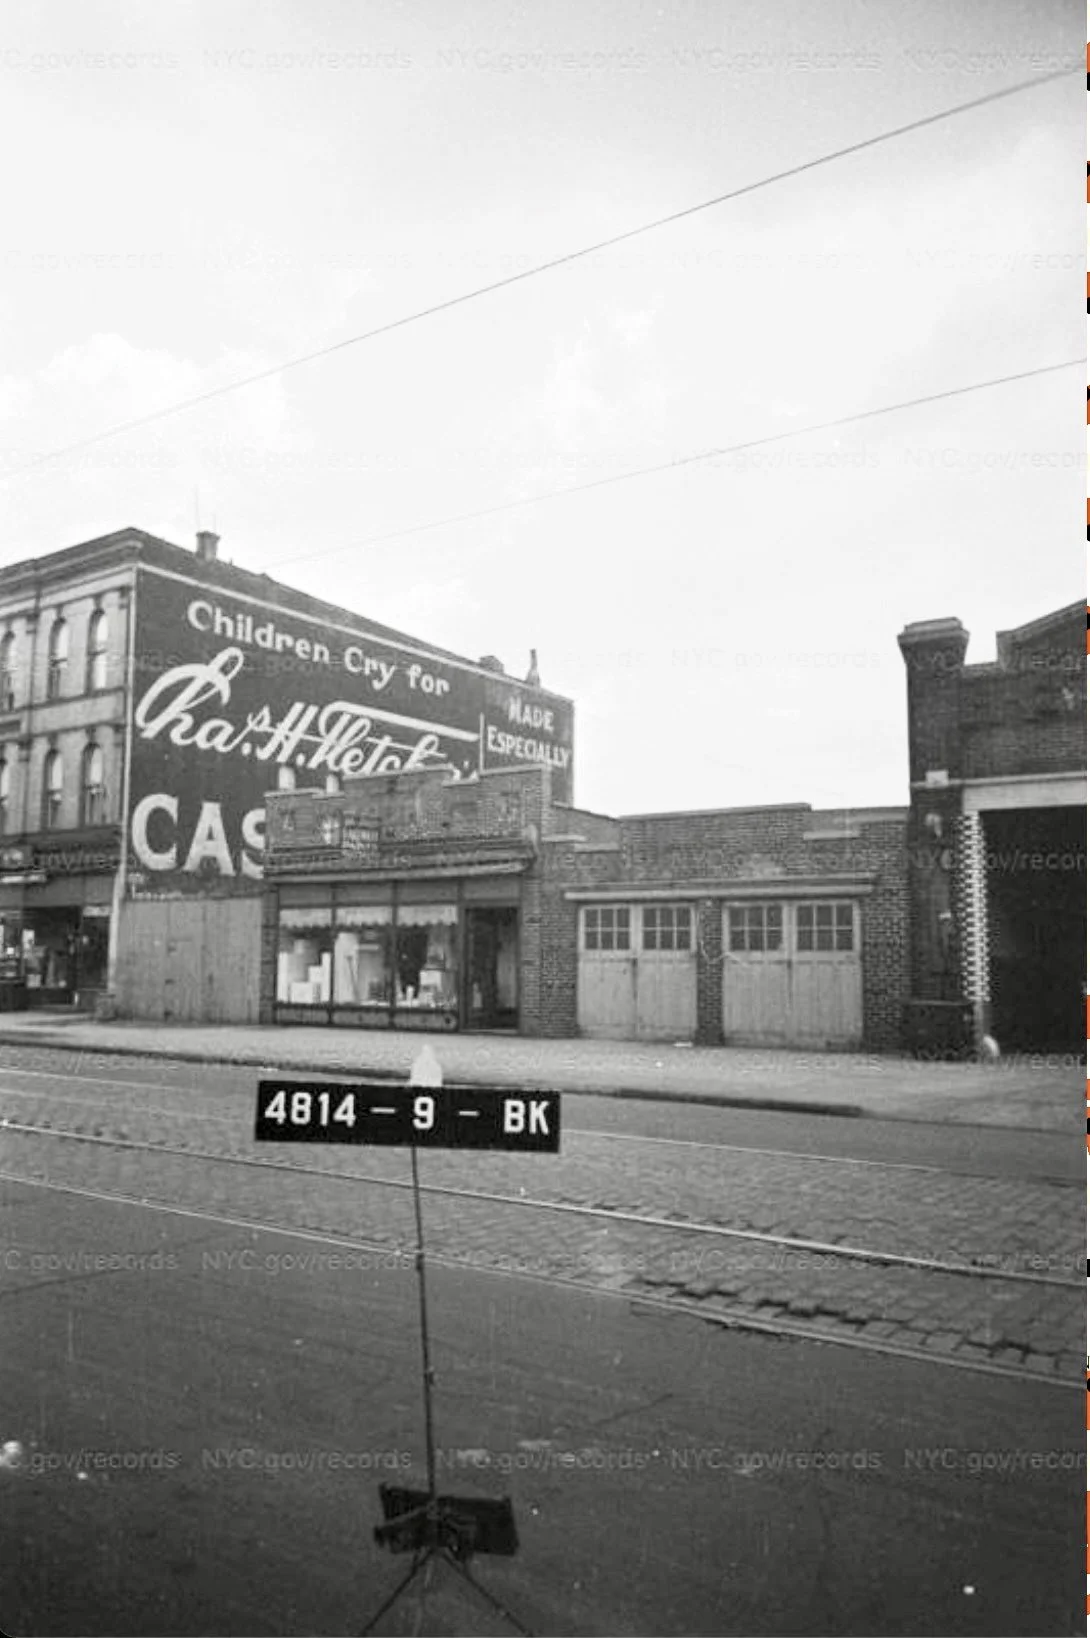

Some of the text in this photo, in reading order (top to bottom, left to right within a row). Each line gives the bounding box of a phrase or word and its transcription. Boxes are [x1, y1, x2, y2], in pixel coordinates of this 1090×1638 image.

[187, 601, 450, 697] Children Cry for
[508, 696, 554, 731] MADE
[487, 724, 569, 768] ESPECIALLY
[264, 1090, 356, 1127] 4814
[413, 1096, 435, 1130] 9
[503, 1098, 550, 1135] BK
